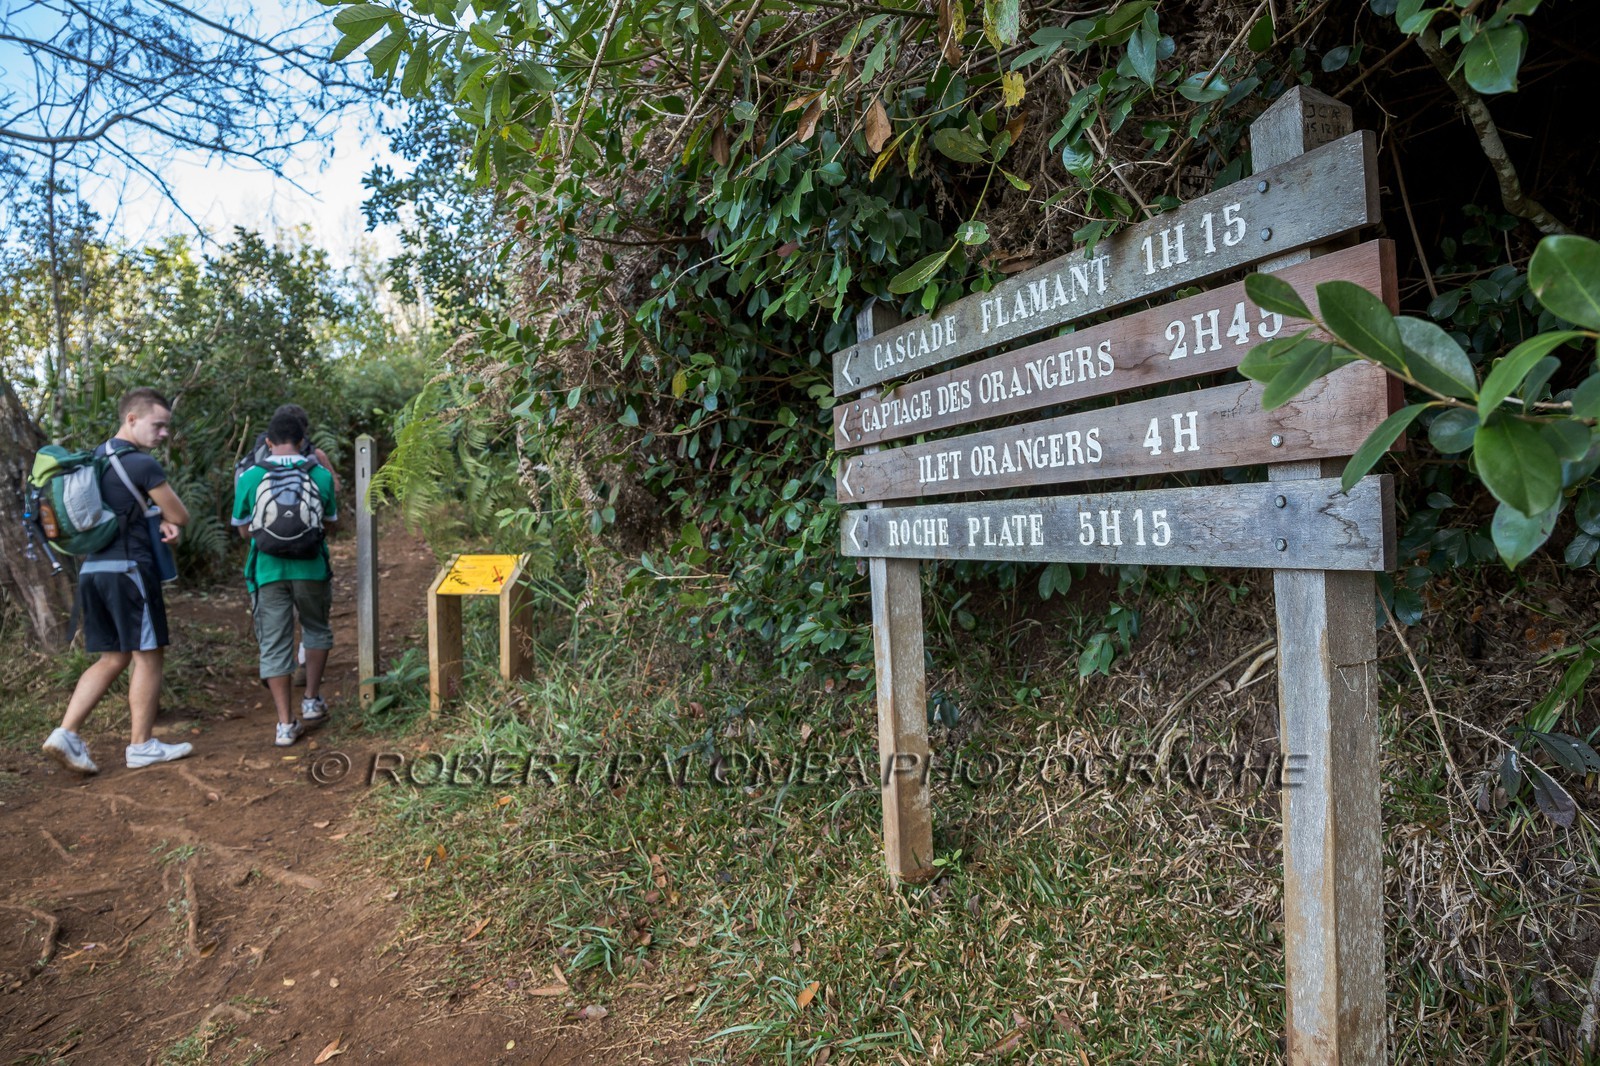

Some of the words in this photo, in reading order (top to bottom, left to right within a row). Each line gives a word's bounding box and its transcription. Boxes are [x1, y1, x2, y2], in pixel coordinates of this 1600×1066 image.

[873, 315, 957, 371] CASCADE
[980, 255, 1111, 334] FLAMANT
[861, 389, 932, 433] CAPTAGE
[937, 379, 972, 416] DES
[978, 338, 1116, 405] ORANGERS
[918, 450, 962, 483] ILET
[970, 427, 1103, 476] ORANGERS
[888, 517, 949, 546] ROCHE
[967, 514, 1044, 547] PLATE
